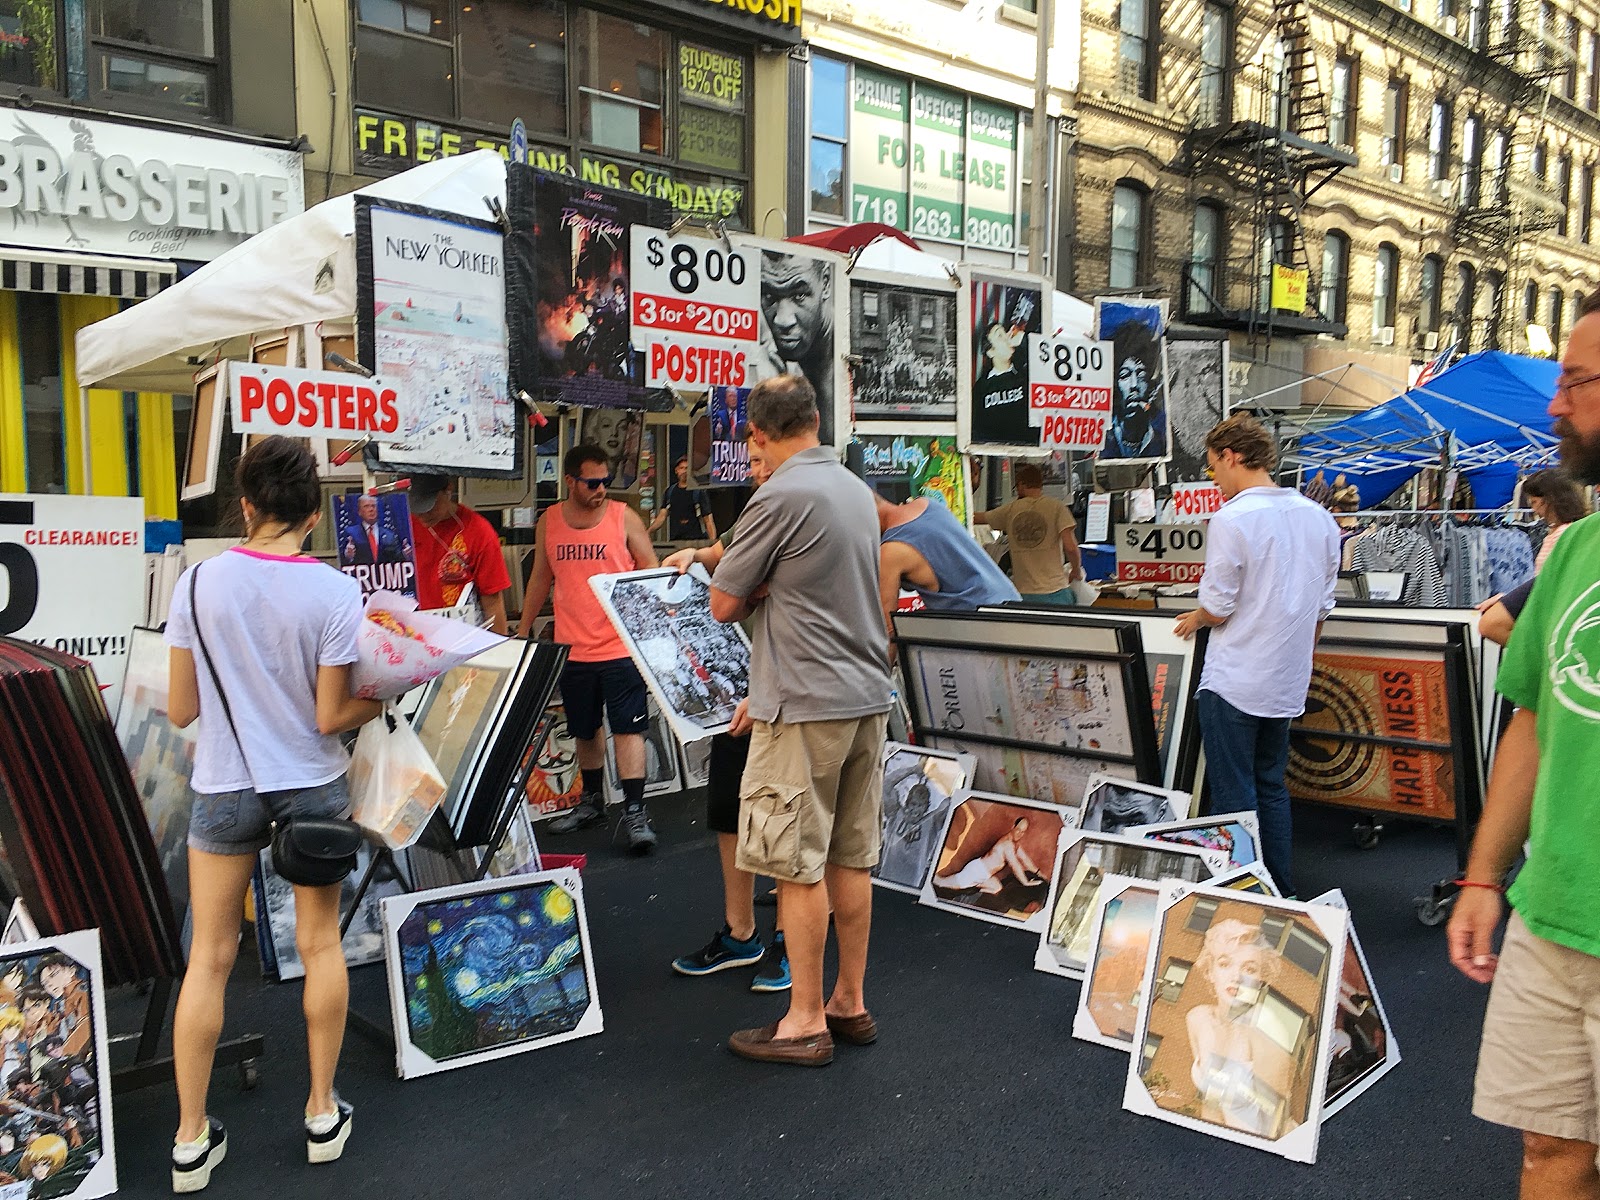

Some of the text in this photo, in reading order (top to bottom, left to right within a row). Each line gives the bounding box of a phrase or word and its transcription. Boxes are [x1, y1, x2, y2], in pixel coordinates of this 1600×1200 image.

[680, 46, 741, 78] STUDENTS
[681, 66, 711, 94] 15%
[713, 74, 741, 100] OFF
[854, 78, 1013, 142] PRIME OFFICE SPACE
[358, 115, 462, 162] FREE
[878, 134, 1006, 191] FOR LEASE
[0, 138, 290, 234] BRASSERIE
[854, 194, 898, 227] 718
[128, 228, 184, 242] Cooking
[432, 233, 454, 246] THE
[386, 236, 502, 277] NEW YORKER
[639, 298, 657, 325] 3
[660, 305, 684, 325] for
[651, 343, 747, 388] POSTERS
[240, 376, 399, 434] POSTERS
[984, 386, 1024, 409] COLLEGE
[1034, 386, 1046, 406] 3
[1047, 390, 1064, 405] for
[1043, 415, 1105, 446] POSTERS
[712, 440, 751, 464] TRUM
[543, 459, 555, 476] A
[720, 463, 748, 482] 2016
[1173, 488, 1227, 516] POSTER
[24, 530, 139, 546] CLEARANCE!
[556, 544, 608, 561] DRINK
[341, 561, 415, 592] TRUMP
[1125, 563, 1138, 580] 3
[1139, 566, 1157, 578] for
[55, 636, 126, 656] ONLY!!
